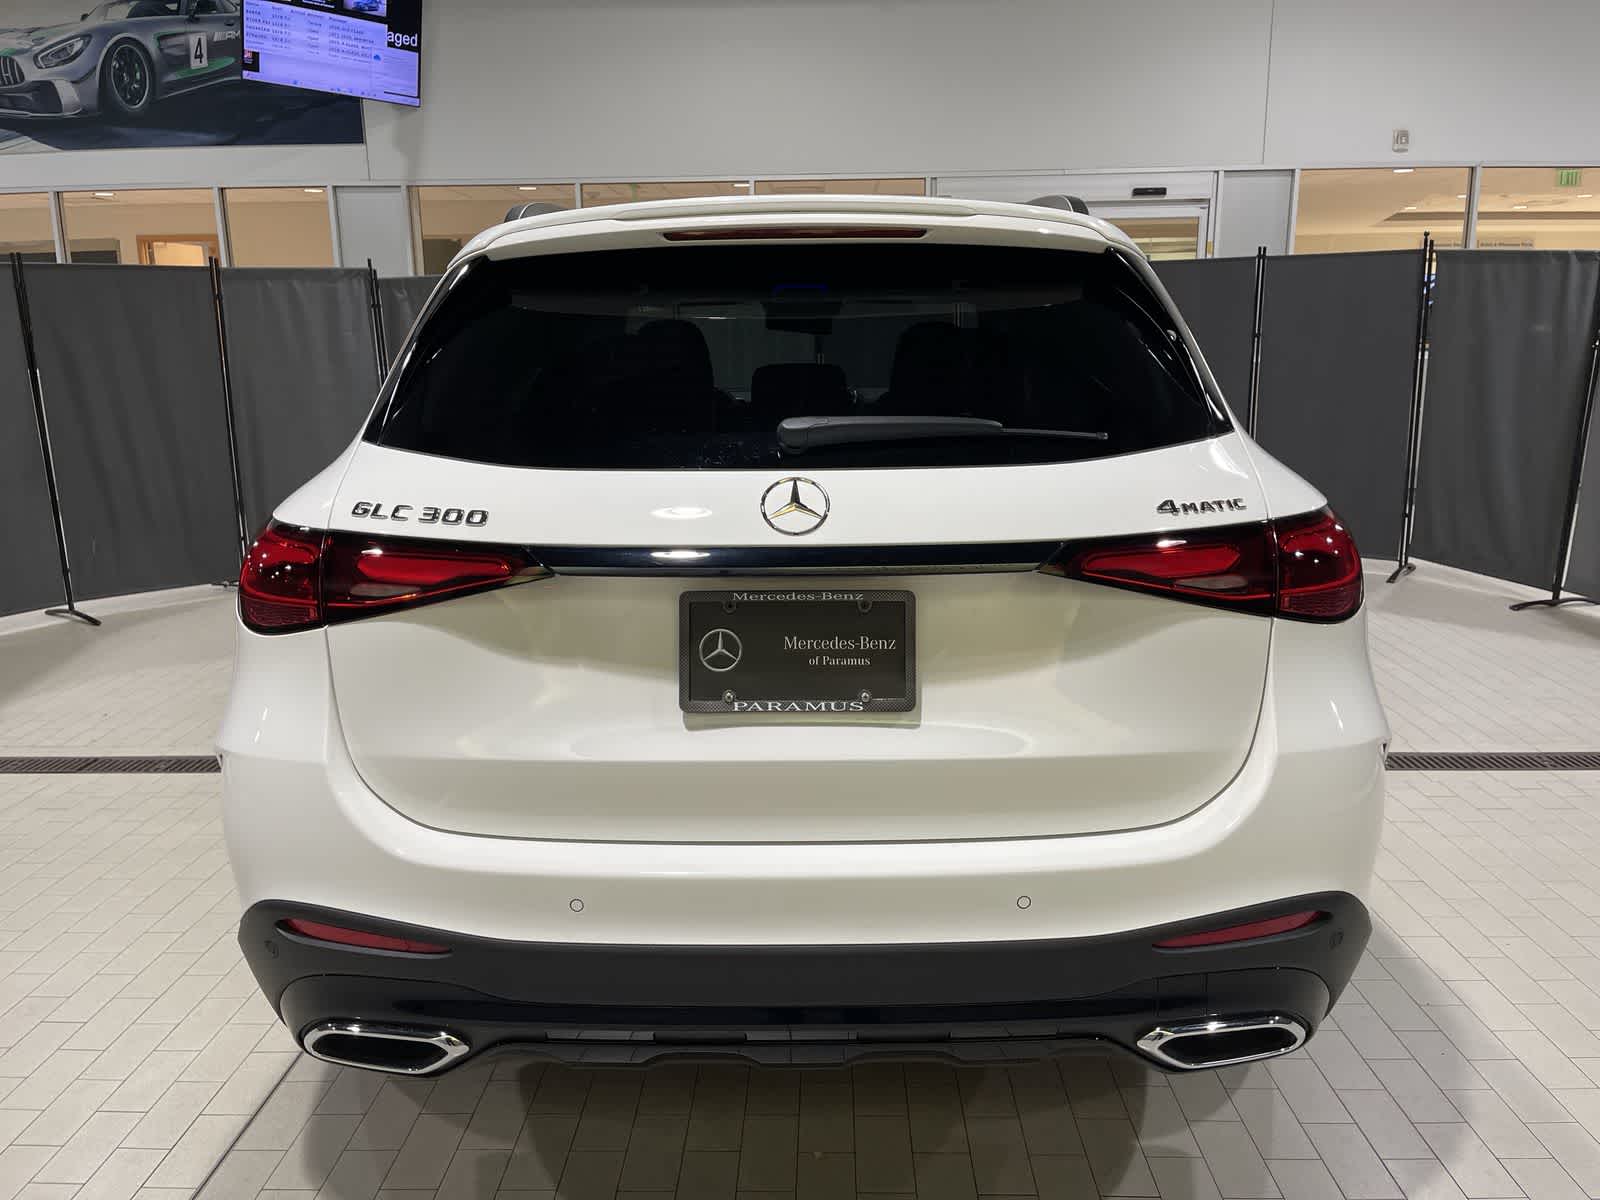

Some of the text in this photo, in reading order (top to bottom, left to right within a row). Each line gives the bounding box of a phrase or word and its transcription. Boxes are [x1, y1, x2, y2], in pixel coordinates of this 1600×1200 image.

[225, 30, 241, 41] AM
[387, 31, 418, 47] aged
[194, 37, 204, 64] 4
[351, 501, 489, 527] GLC 300
[1156, 498, 1247, 516] 4MATIC
[733, 591, 864, 601] Mercedes-Benz
[783, 635, 897, 651] Mercedes-Benz
[808, 655, 871, 666] of Paramus
[732, 701, 865, 712] PARAMUS
